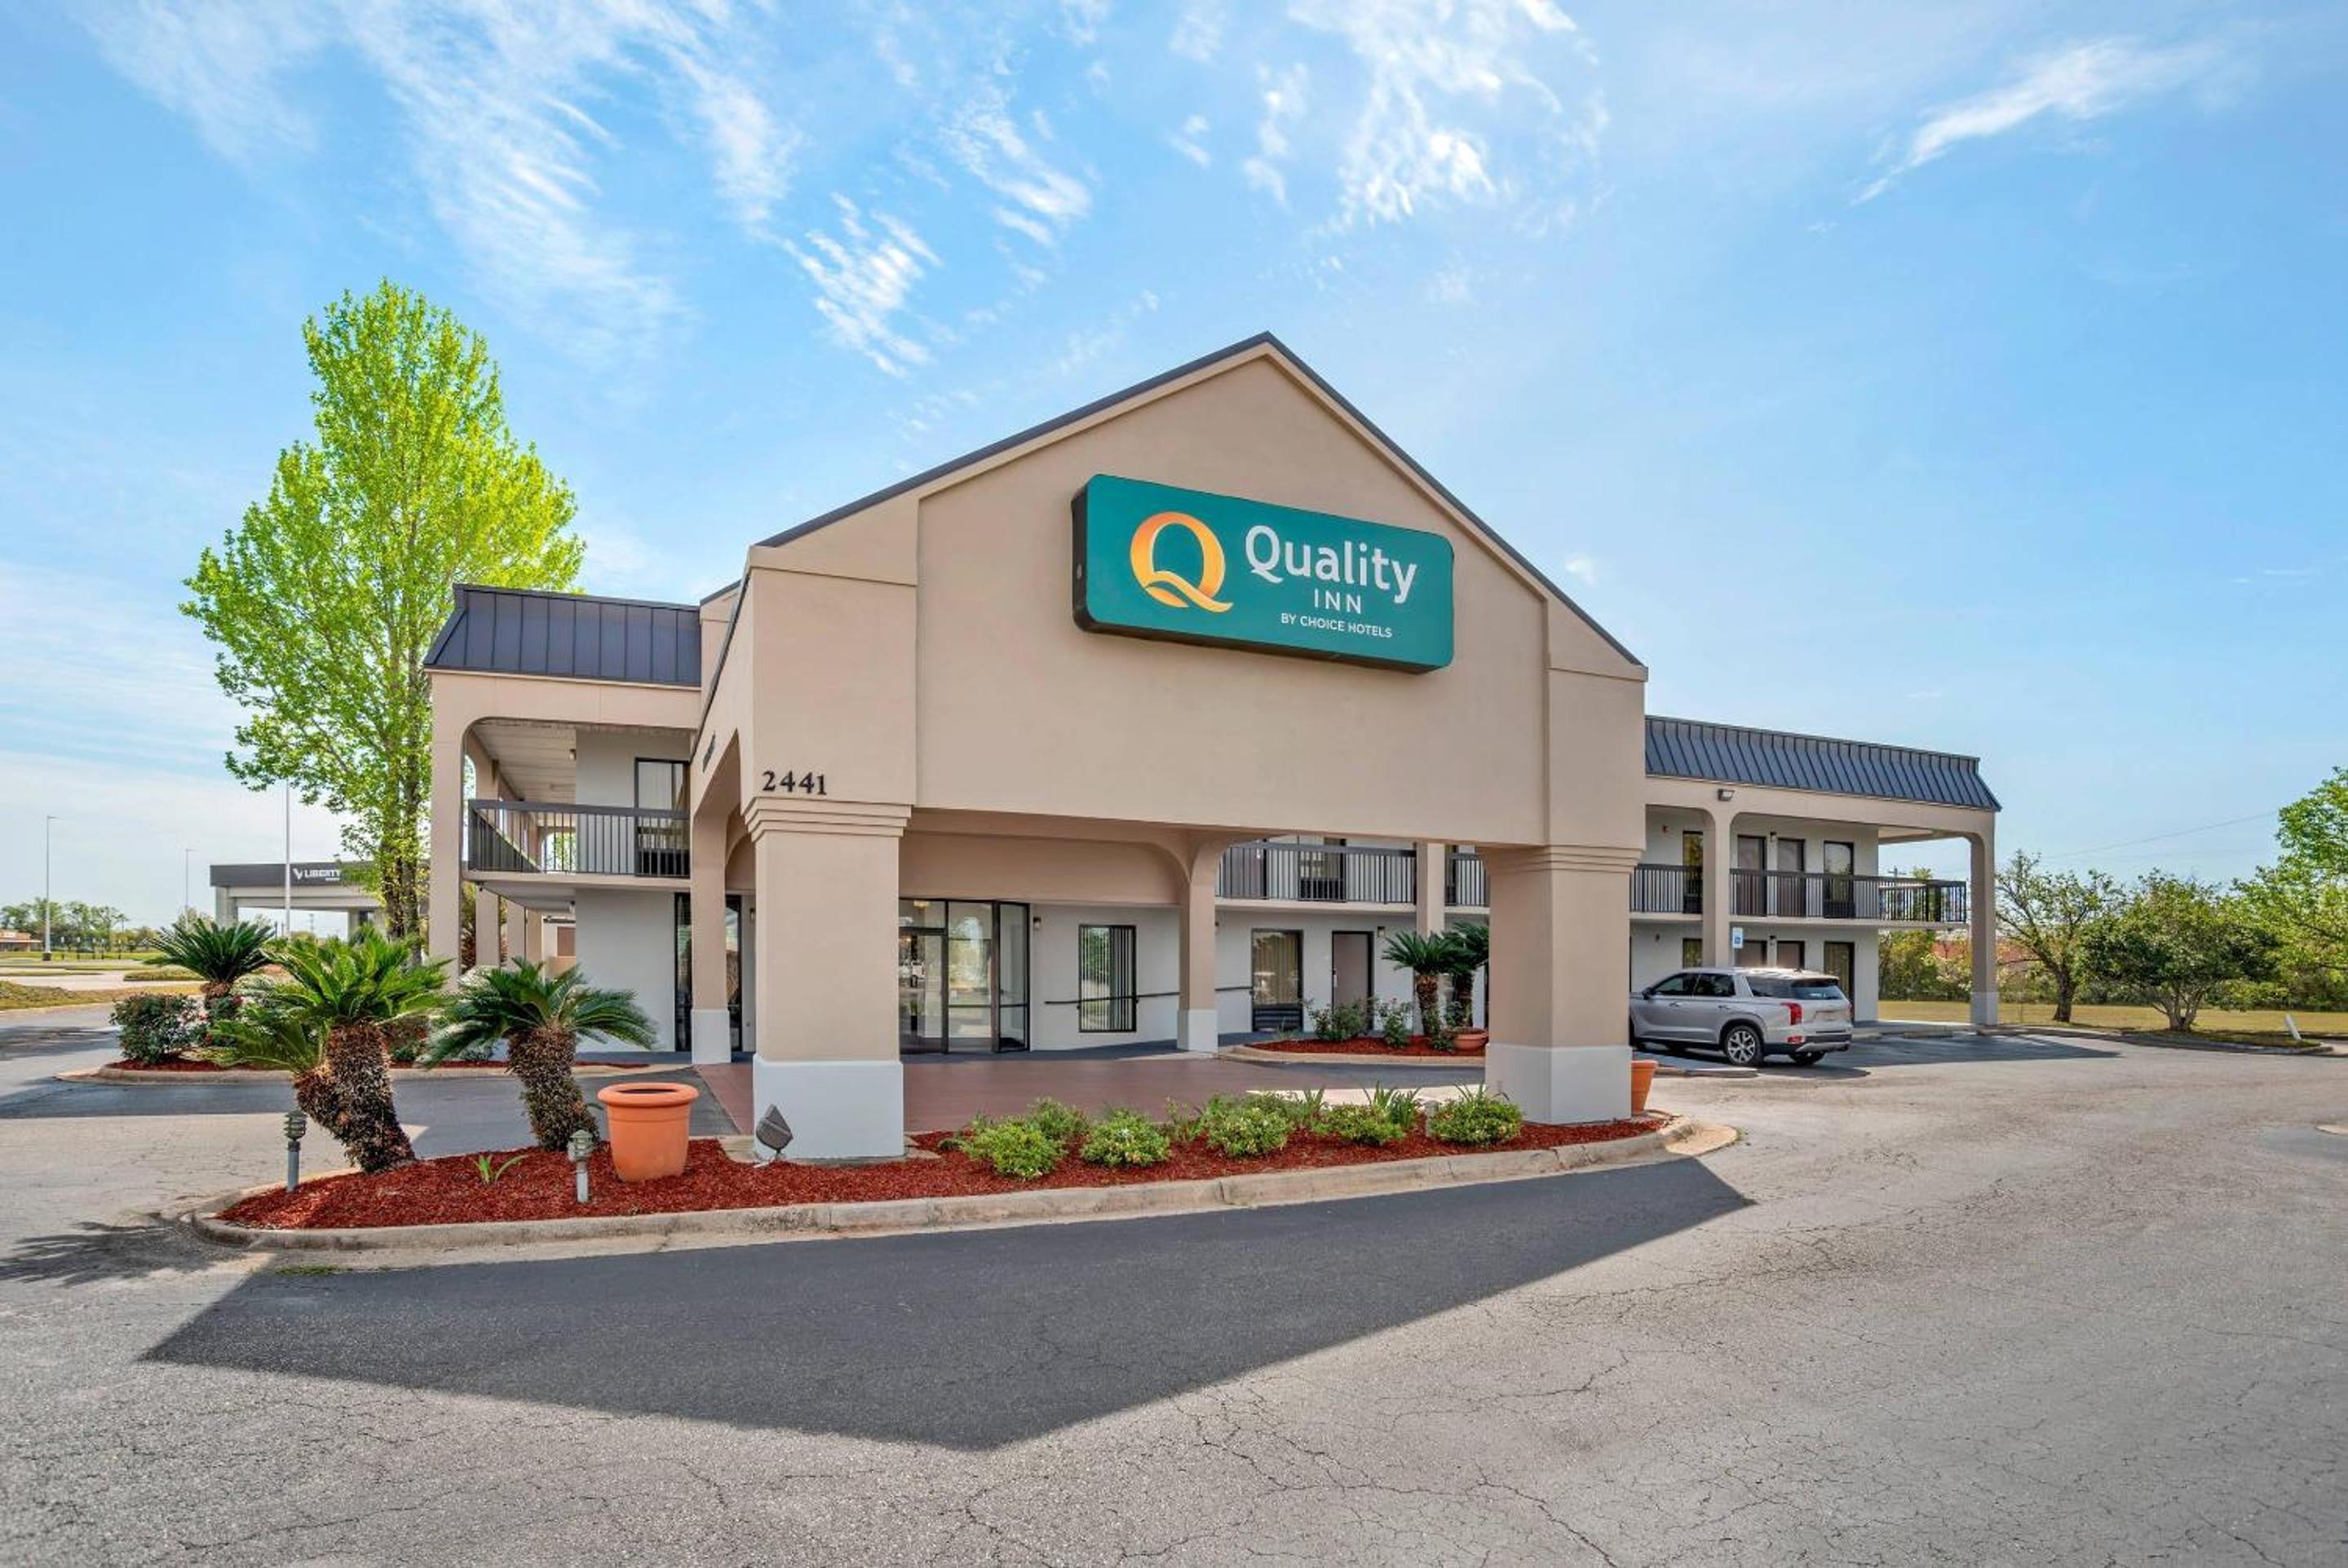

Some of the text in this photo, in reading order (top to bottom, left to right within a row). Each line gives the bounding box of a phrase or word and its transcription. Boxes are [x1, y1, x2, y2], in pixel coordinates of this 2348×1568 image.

[1245, 524, 1417, 603] Quality
[1314, 587, 1362, 614] INN
[1280, 612, 1393, 638] BY CHOICE HOTELS
[762, 770, 827, 796] 2441
